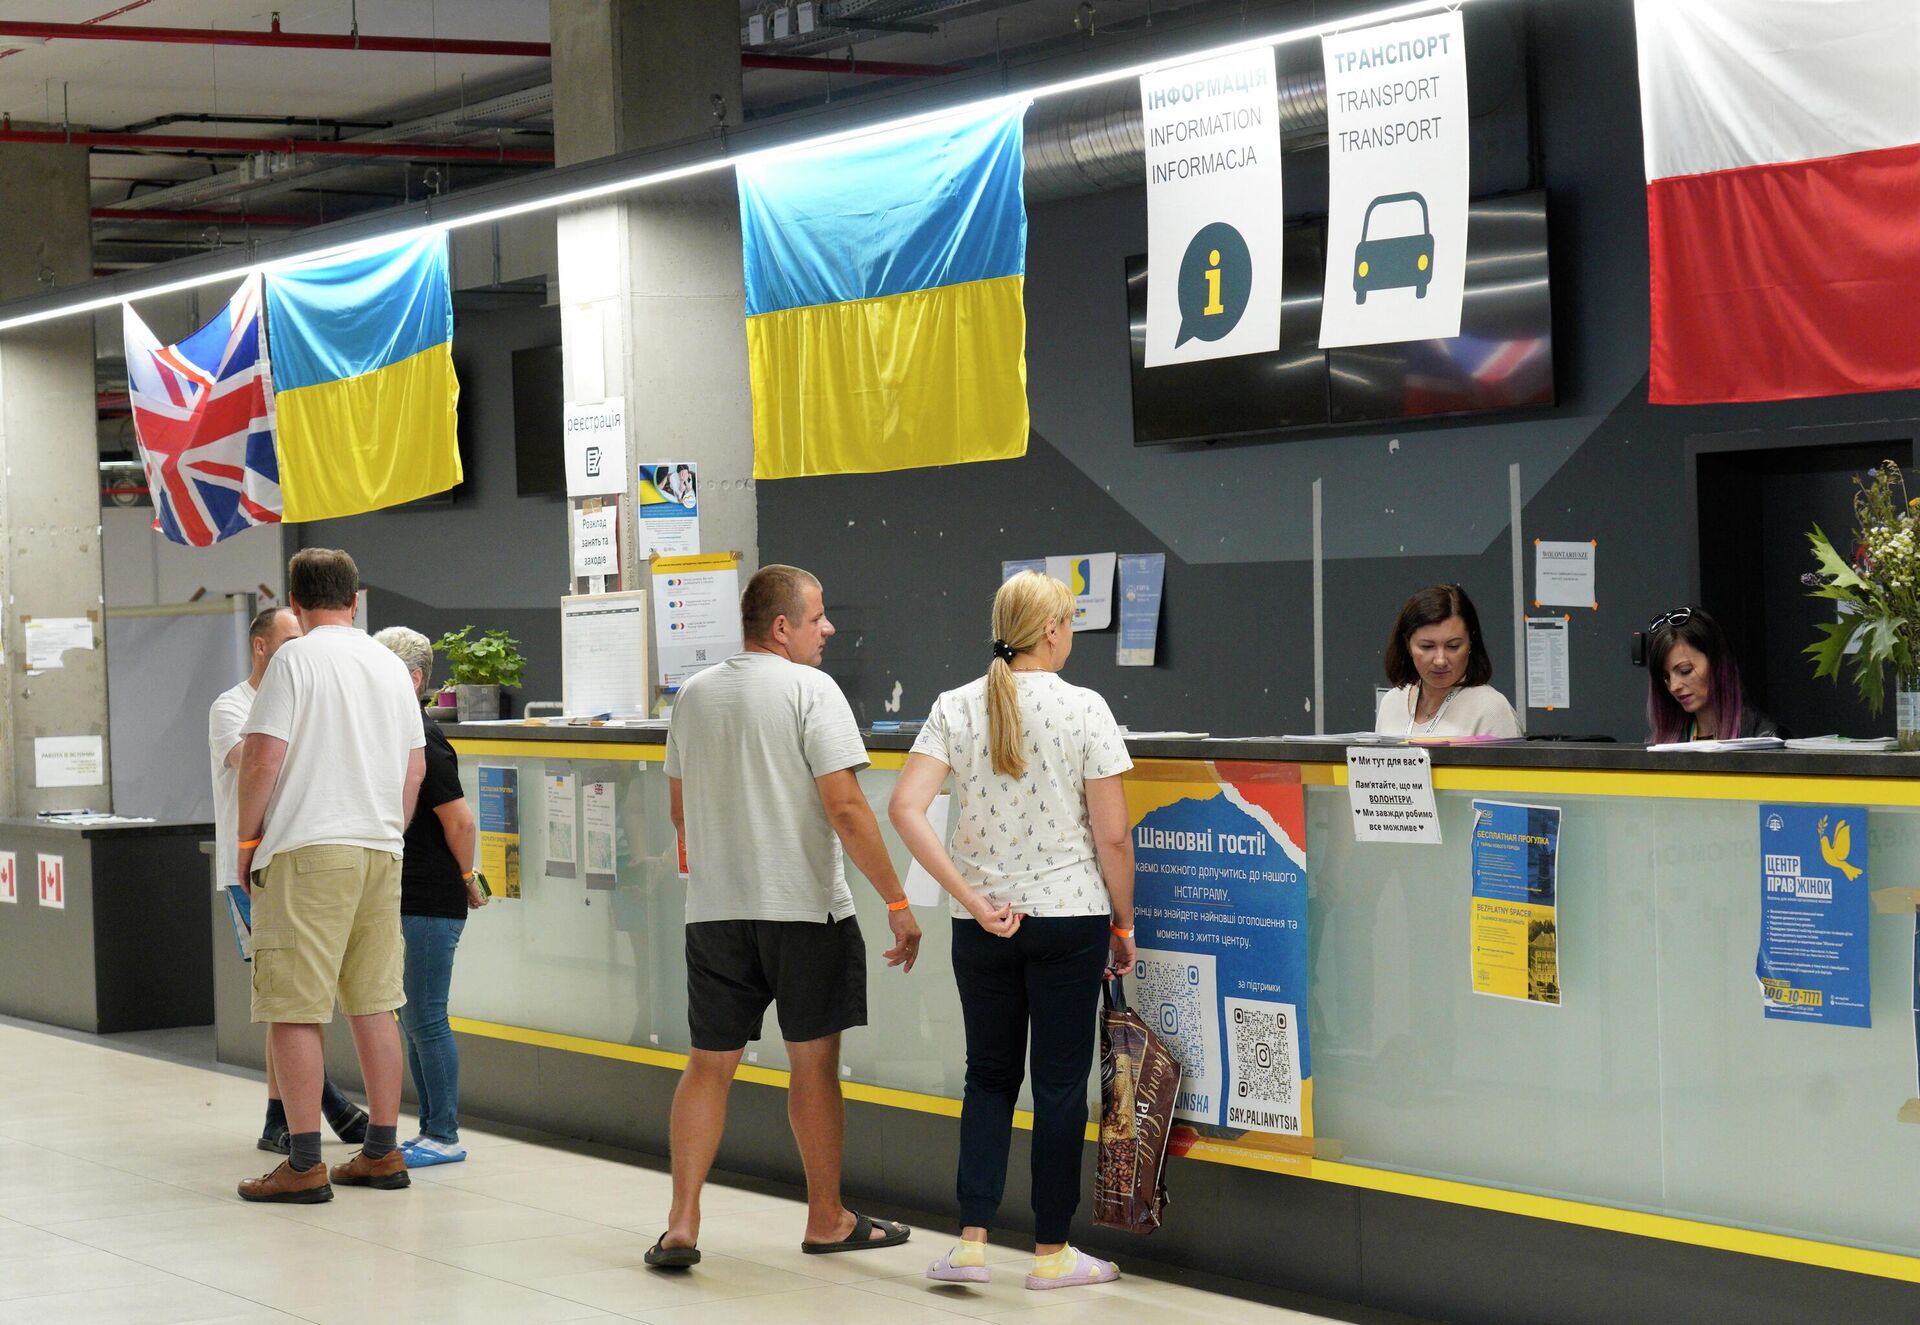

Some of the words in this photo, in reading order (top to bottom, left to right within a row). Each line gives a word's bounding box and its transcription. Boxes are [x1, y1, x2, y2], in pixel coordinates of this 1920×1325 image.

[1335, 33, 1451, 74] ТРАНСПОРТ
[1147, 67, 1268, 110] ІНФОРМАЦІЯ
[1337, 76, 1440, 114] TRANSPORT
[1150, 107, 1262, 148] INFORMATION
[1338, 117, 1442, 153] TRANSPORT
[1152, 146, 1257, 185] INFORMACJA
[567, 410, 621, 435] реєстрація
[582, 518, 607, 529] Розклад
[602, 536, 609, 545] та
[584, 555, 606, 566] заходів
[1358, 756, 1371, 765] Ми
[1372, 758, 1386, 767] тут
[1387, 758, 1401, 767] для
[1403, 758, 1417, 766] вас
[1355, 780, 1398, 790] Пам'ятайте,
[1399, 783, 1410, 791] що
[1369, 795, 1414, 804] ВОЛОНТЕРИ.
[1362, 808, 1374, 816] Ми
[1376, 810, 1404, 819] завжди
[1406, 809, 1433, 819] робимо
[1383, 824, 1417, 832] можливе
[1477, 830, 1517, 842] БЕСПЛАТНАЯ
[1518, 834, 1549, 845] ПРОГУЛКА
[1137, 826, 1212, 853] Шановні
[1218, 831, 1266, 856] гості!
[1160, 863, 1196, 876] кожного
[1198, 865, 1247, 881] долучитись
[1249, 870, 1261, 883] до
[1262, 873, 1297, 884] нашого
[1767, 857, 1799, 873] ЦЕНТР
[1174, 885, 1231, 902] ІНСТАГРАМУ.
[1767, 876, 1795, 893] ПРАВ
[1797, 878, 1831, 895] ЖІНОК
[1153, 908, 1162, 917] ви
[1164, 907, 1198, 921] знайдете
[1200, 912, 1236, 924] найновші
[1238, 916, 1285, 929] оголошення
[1287, 919, 1298, 929] та
[1477, 903, 1508, 914] BEZPLATNY
[1510, 907, 1531, 917] SPACER
[1156, 929, 1189, 941] моменти
[1190, 932, 1194, 942] з
[1196, 933, 1220, 943] життя
[1221, 935, 1251, 949] центру.
[1238, 980, 1246, 989] за
[1247, 979, 1281, 993] підтримки
[1174, 1092, 1209, 1114] LINSKA
[1229, 1107, 1298, 1131] SAY.PALIANYTSIA
